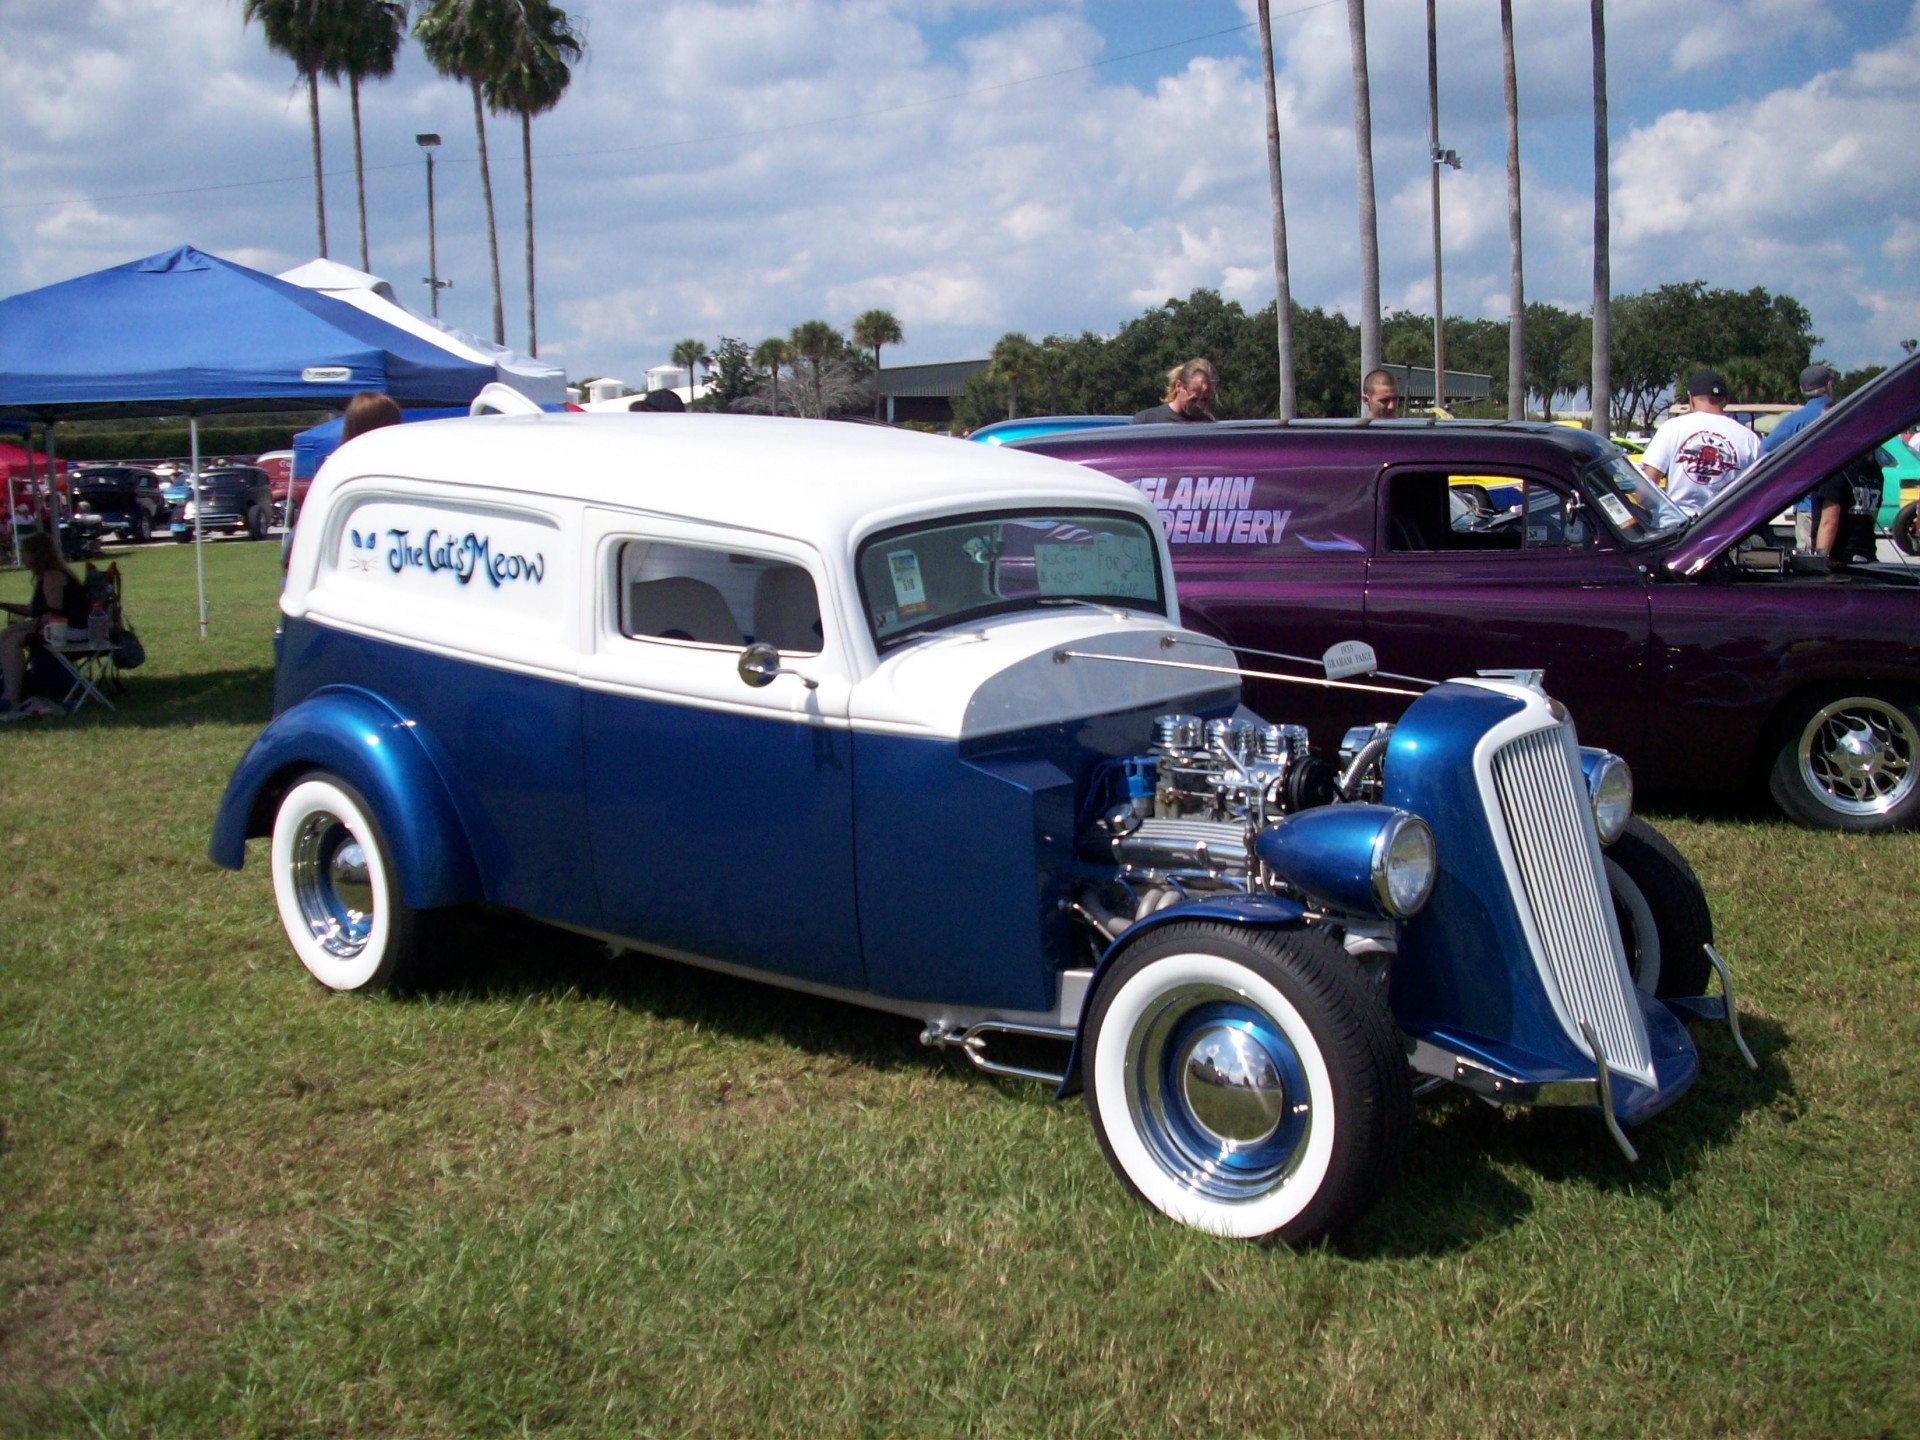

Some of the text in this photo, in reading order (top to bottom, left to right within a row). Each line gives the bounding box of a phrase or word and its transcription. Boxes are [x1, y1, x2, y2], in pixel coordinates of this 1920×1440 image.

[1139, 477, 1255, 510] FLAMIN
[386, 528, 424, 574] The
[425, 528, 465, 572] Cat's
[1327, 655, 1353, 669] GRAHAM
